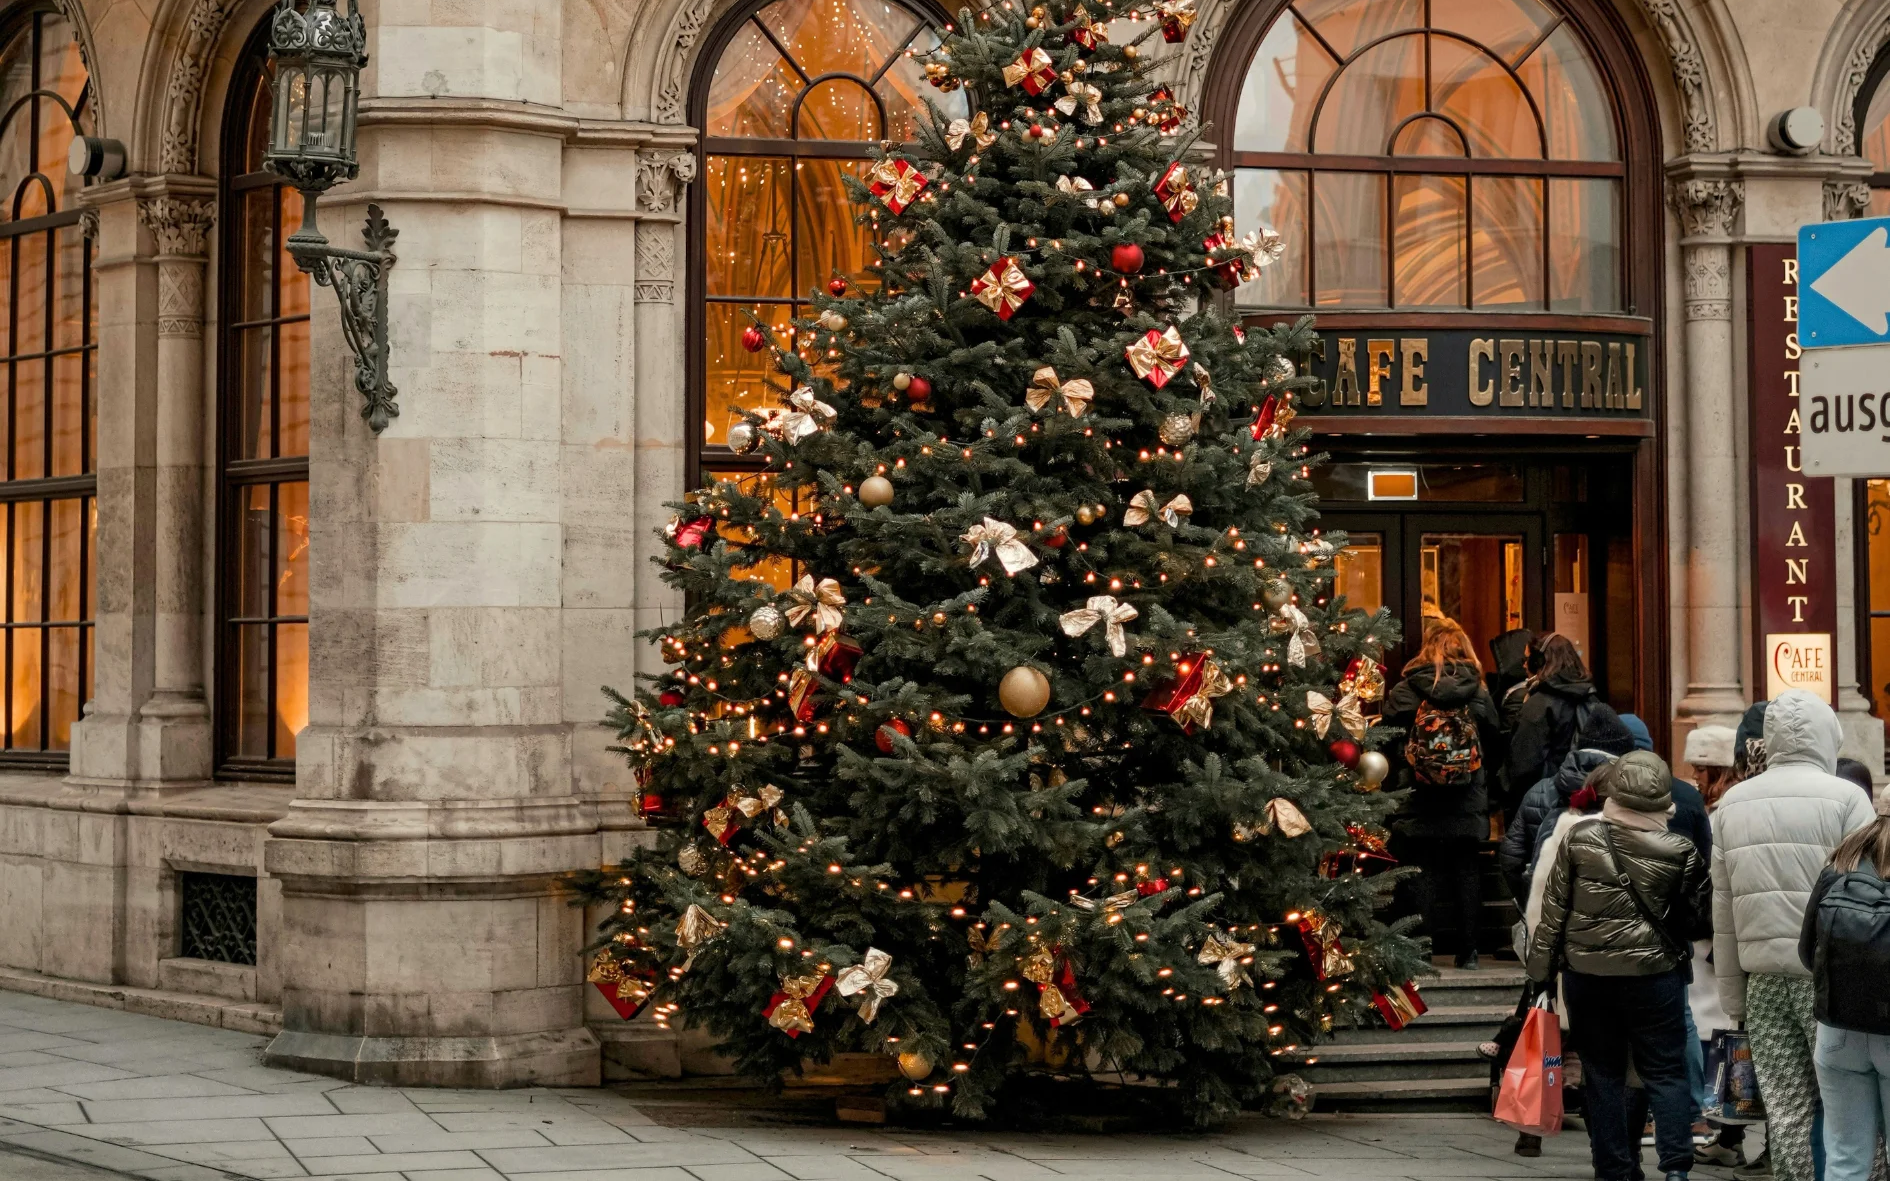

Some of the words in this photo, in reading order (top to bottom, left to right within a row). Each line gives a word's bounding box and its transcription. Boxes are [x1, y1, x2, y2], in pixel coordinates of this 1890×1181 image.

[1301, 338, 1428, 406] CAFE
[1468, 338, 1642, 410] CENTRAL
[1782, 258, 1808, 622] RESTAURANT
[1774, 641, 1823, 688] CAFE
[1791, 671, 1824, 682] CENTRAL
